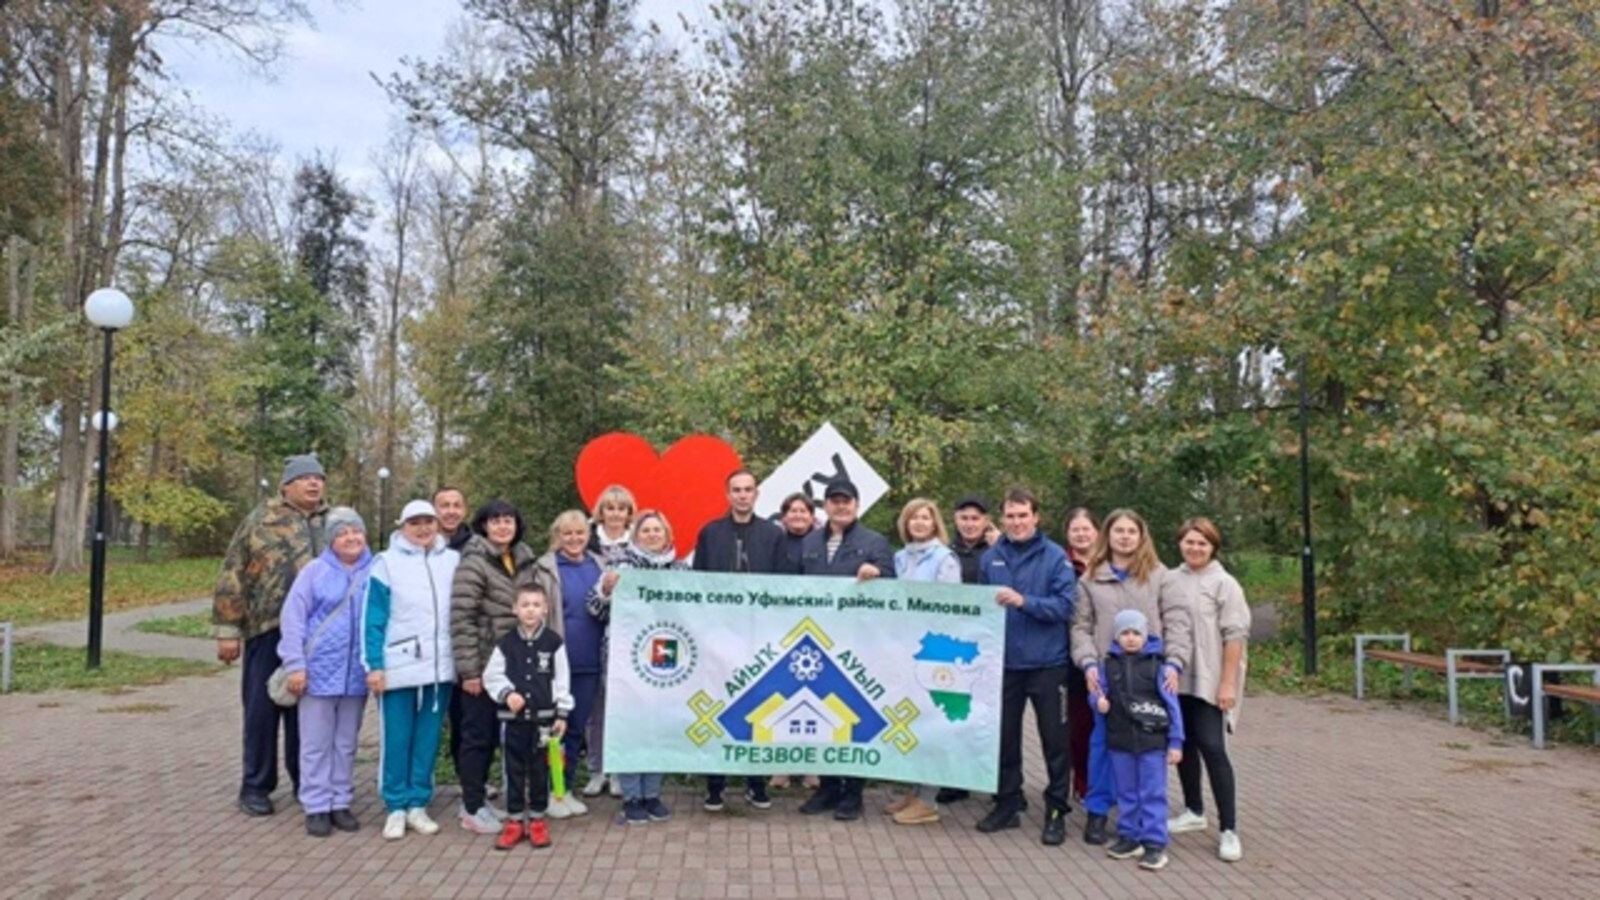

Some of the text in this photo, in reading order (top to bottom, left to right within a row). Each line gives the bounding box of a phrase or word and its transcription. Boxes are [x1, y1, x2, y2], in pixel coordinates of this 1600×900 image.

[636, 586, 702, 603] Трезвое
[706, 592, 743, 604] село
[837, 594, 885, 610] район
[907, 598, 981, 616] Миловка
[837, 650, 886, 701] АУЫЛ
[722, 745, 881, 766] ТРЕЗВОЕ СЕЛО
